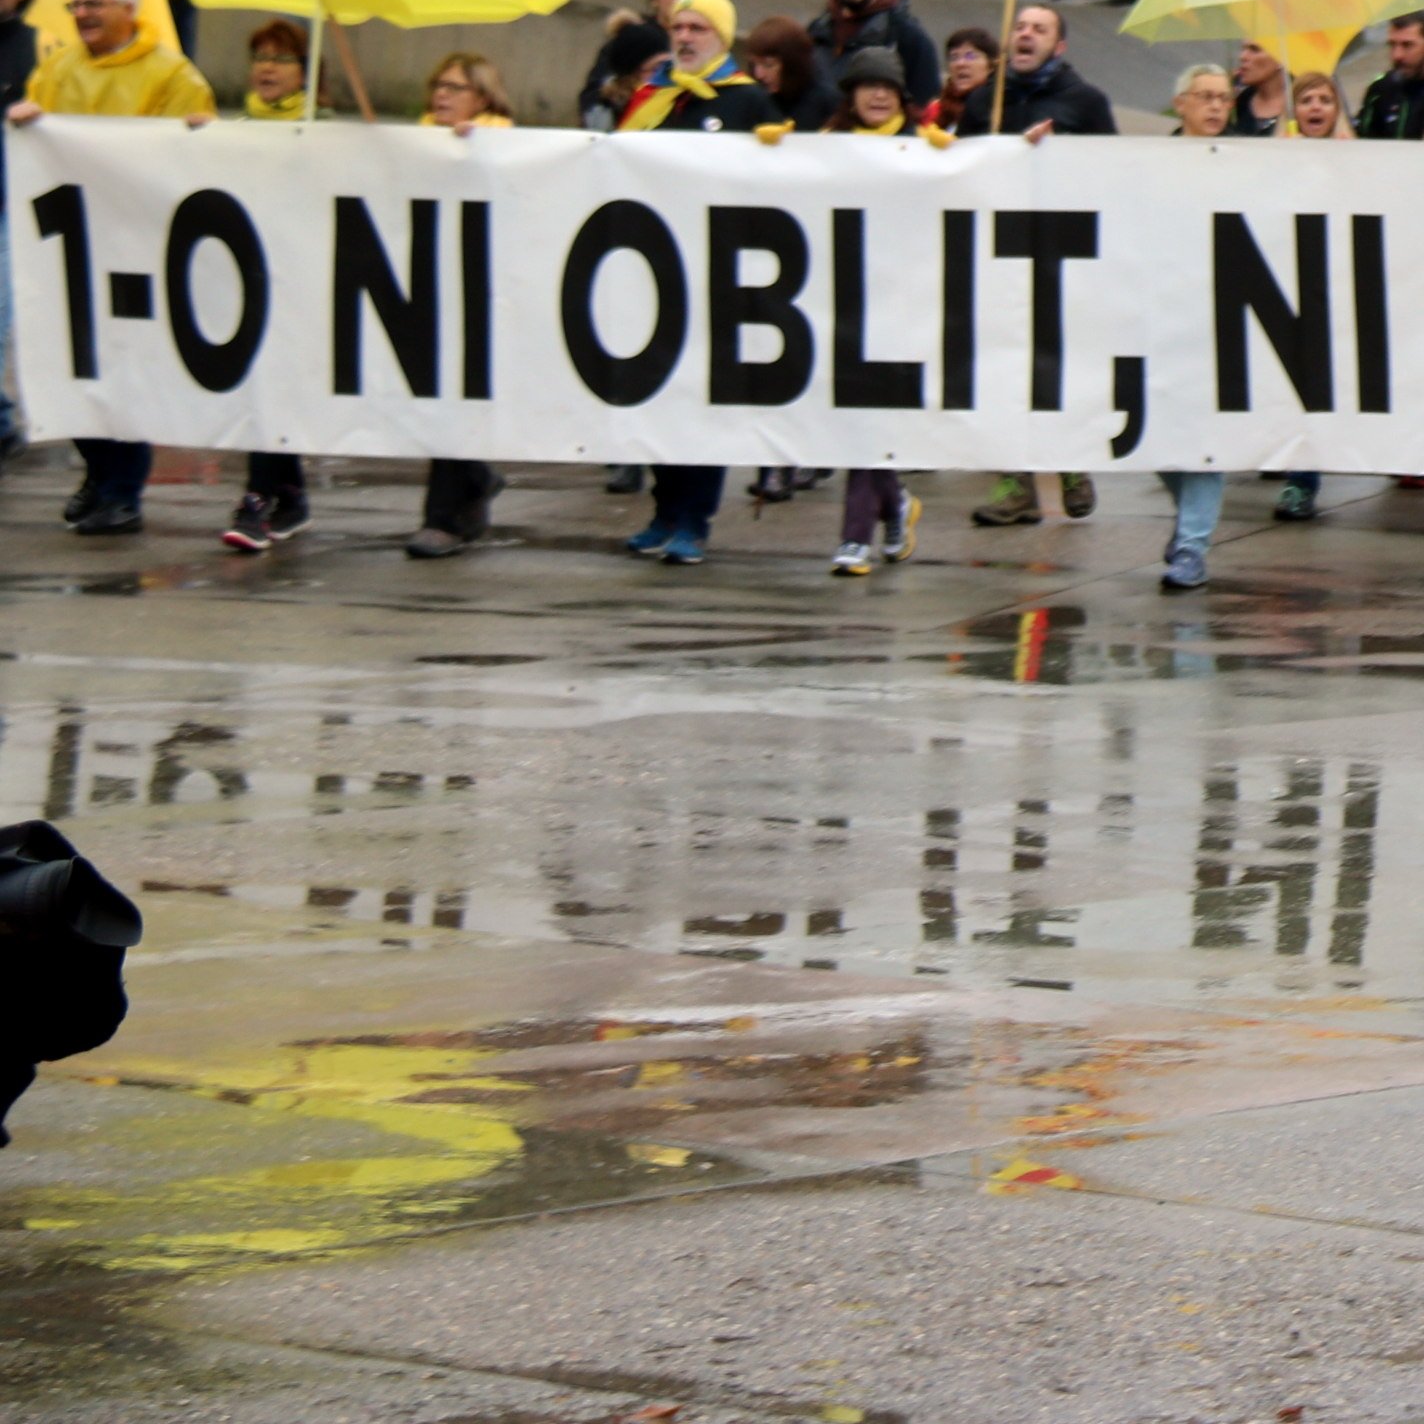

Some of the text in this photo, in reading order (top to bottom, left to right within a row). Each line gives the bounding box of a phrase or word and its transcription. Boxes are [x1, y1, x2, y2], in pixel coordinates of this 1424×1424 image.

[332, 195, 493, 400] NI
[559, 199, 1147, 459] OBLIT,
[1212, 212, 1391, 414] NI
